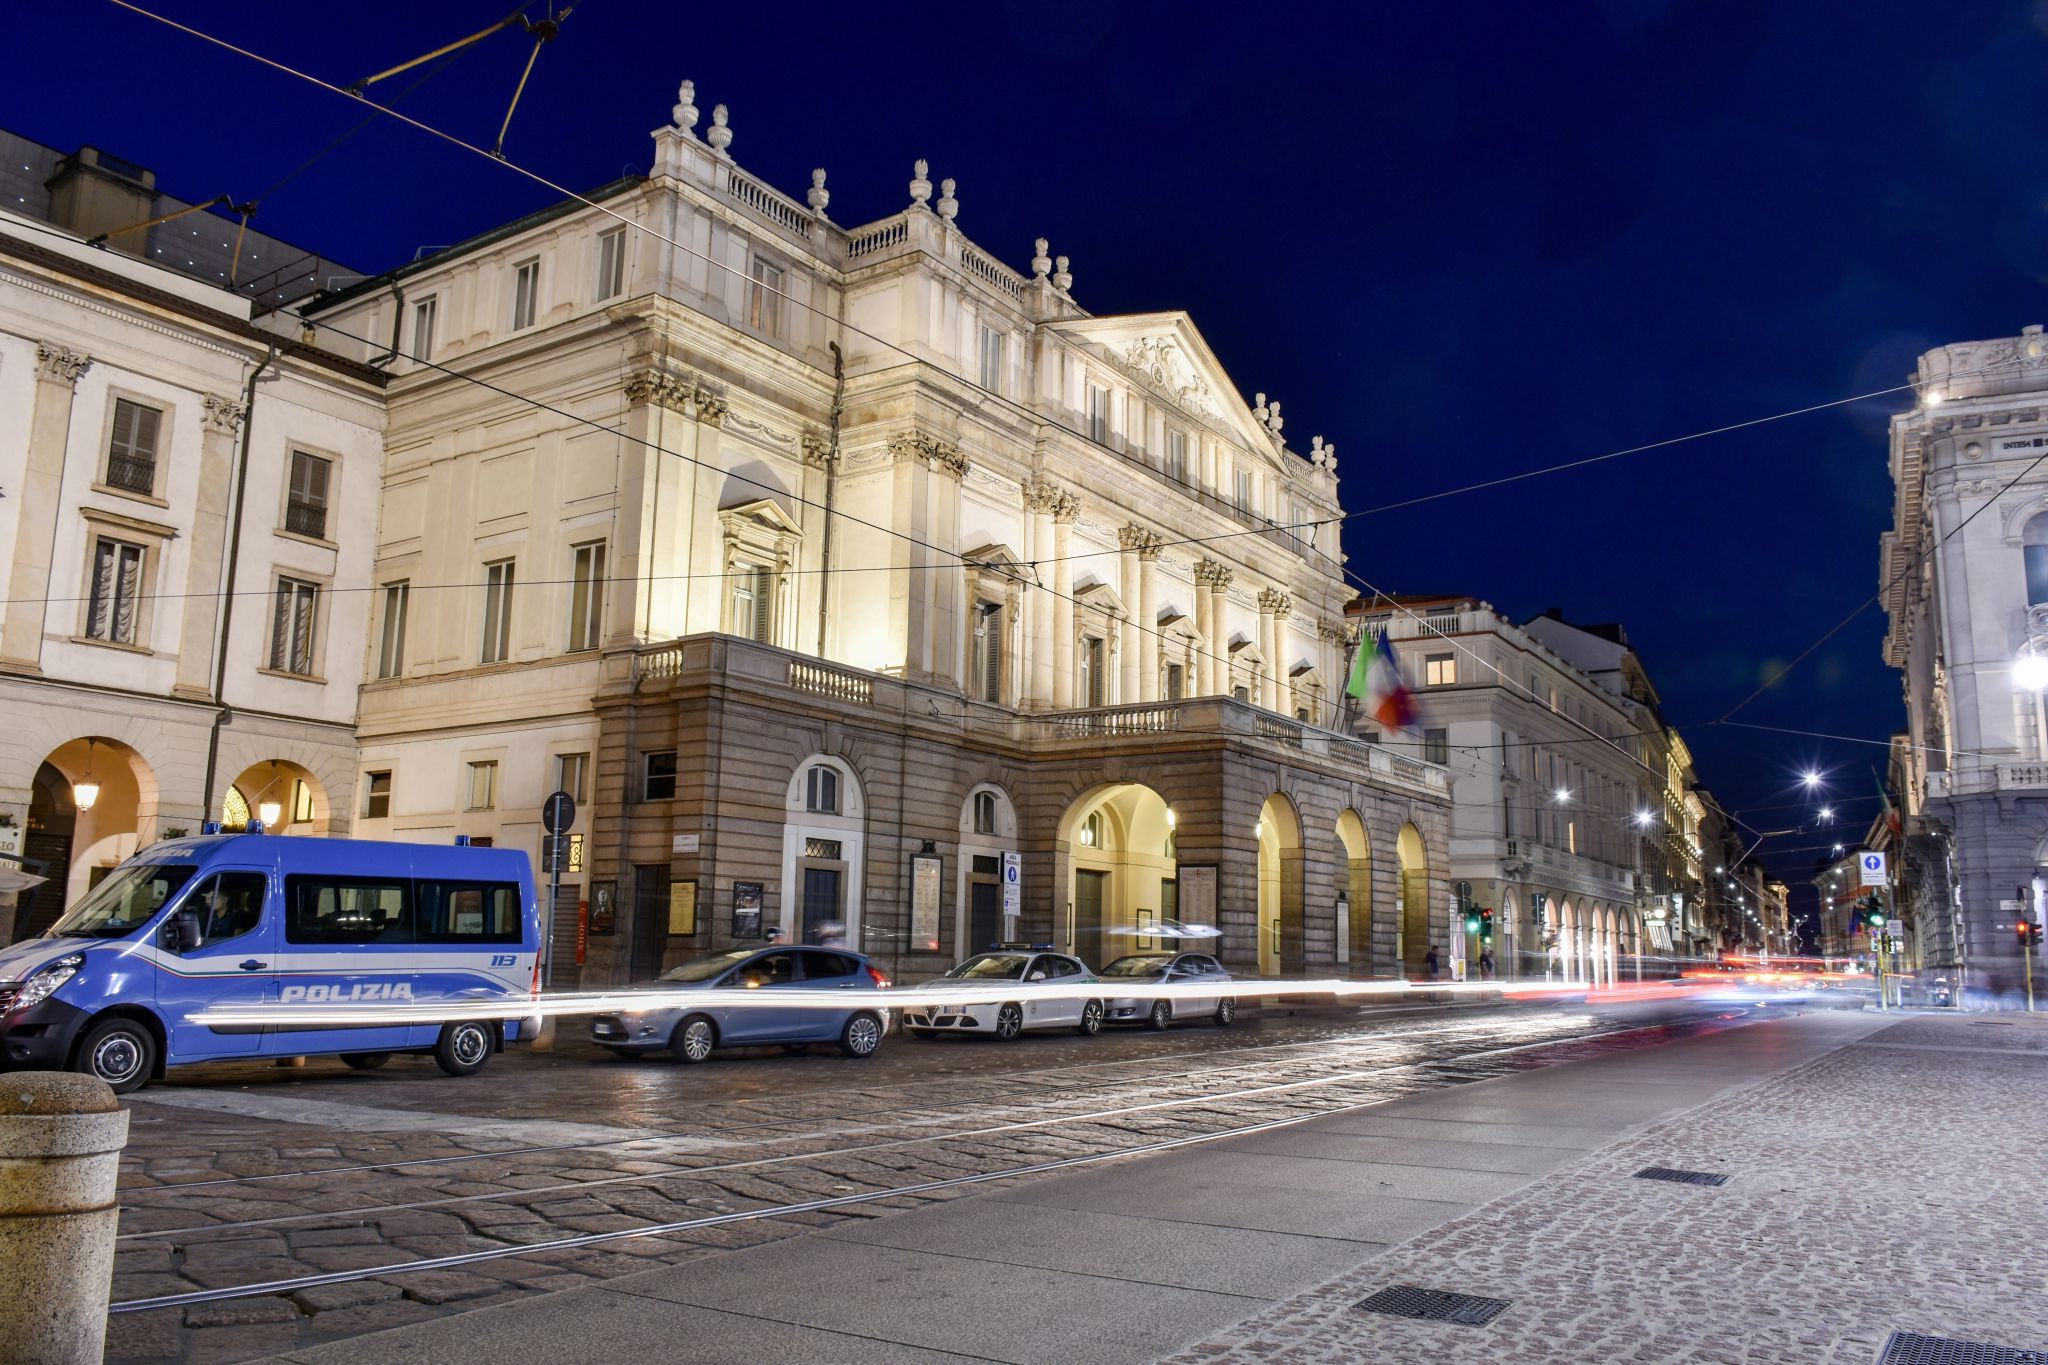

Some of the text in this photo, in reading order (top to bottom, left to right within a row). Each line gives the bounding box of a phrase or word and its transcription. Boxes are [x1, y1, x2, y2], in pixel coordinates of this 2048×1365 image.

[2003, 441, 2031, 449] INTESA
[491, 955, 517, 966] 113
[281, 983, 414, 1002] POLIZIA
